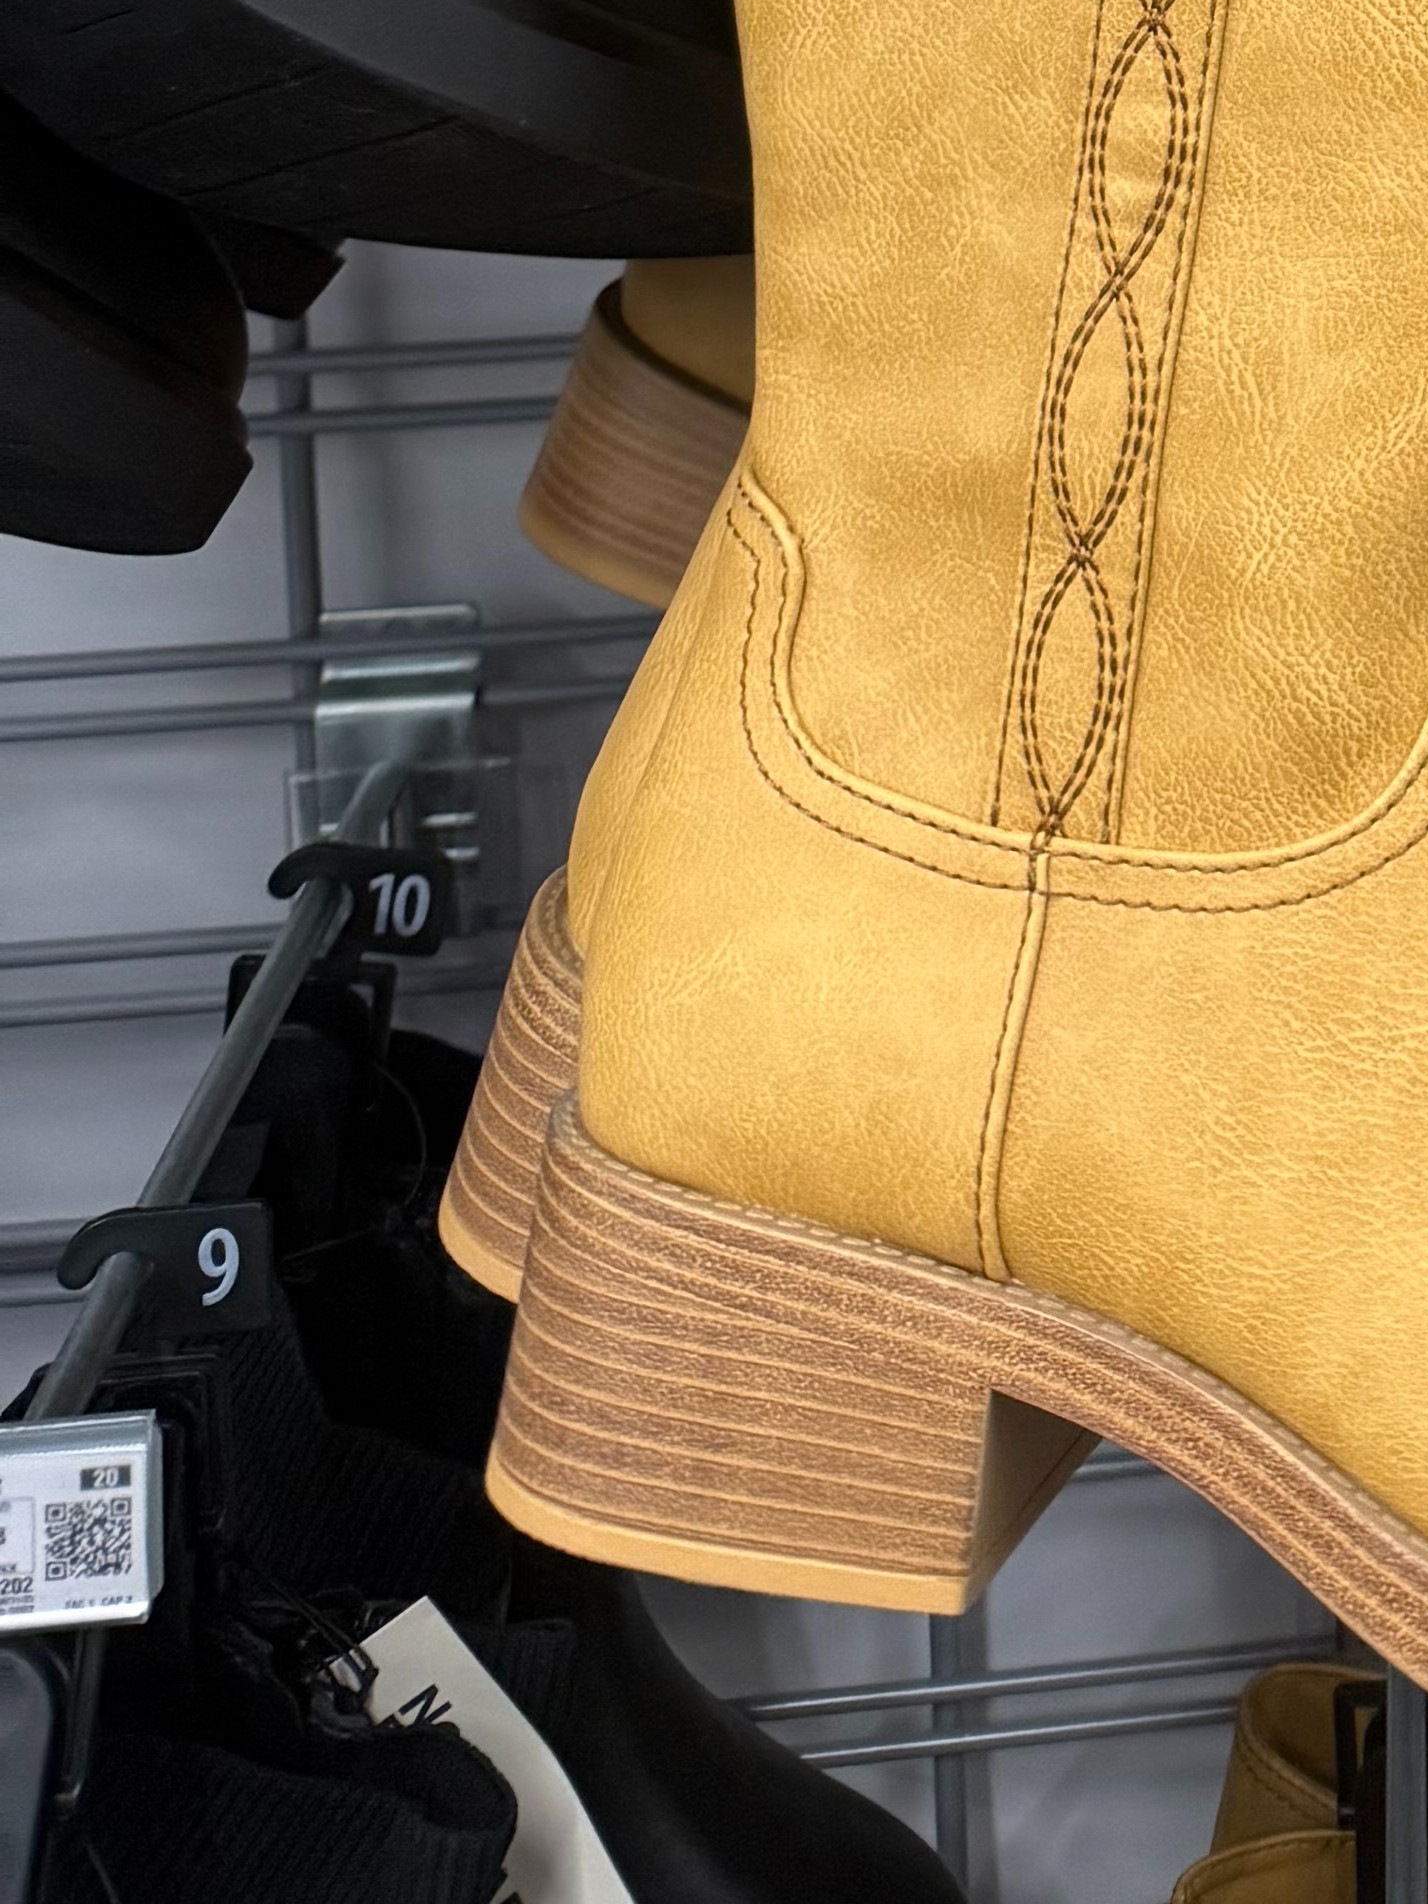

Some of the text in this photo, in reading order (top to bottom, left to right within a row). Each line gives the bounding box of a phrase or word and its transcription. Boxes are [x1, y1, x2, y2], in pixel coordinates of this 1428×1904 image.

[367, 873, 431, 937] 10
[197, 1227, 240, 1307] 9
[92, 1467, 120, 1488] 20
